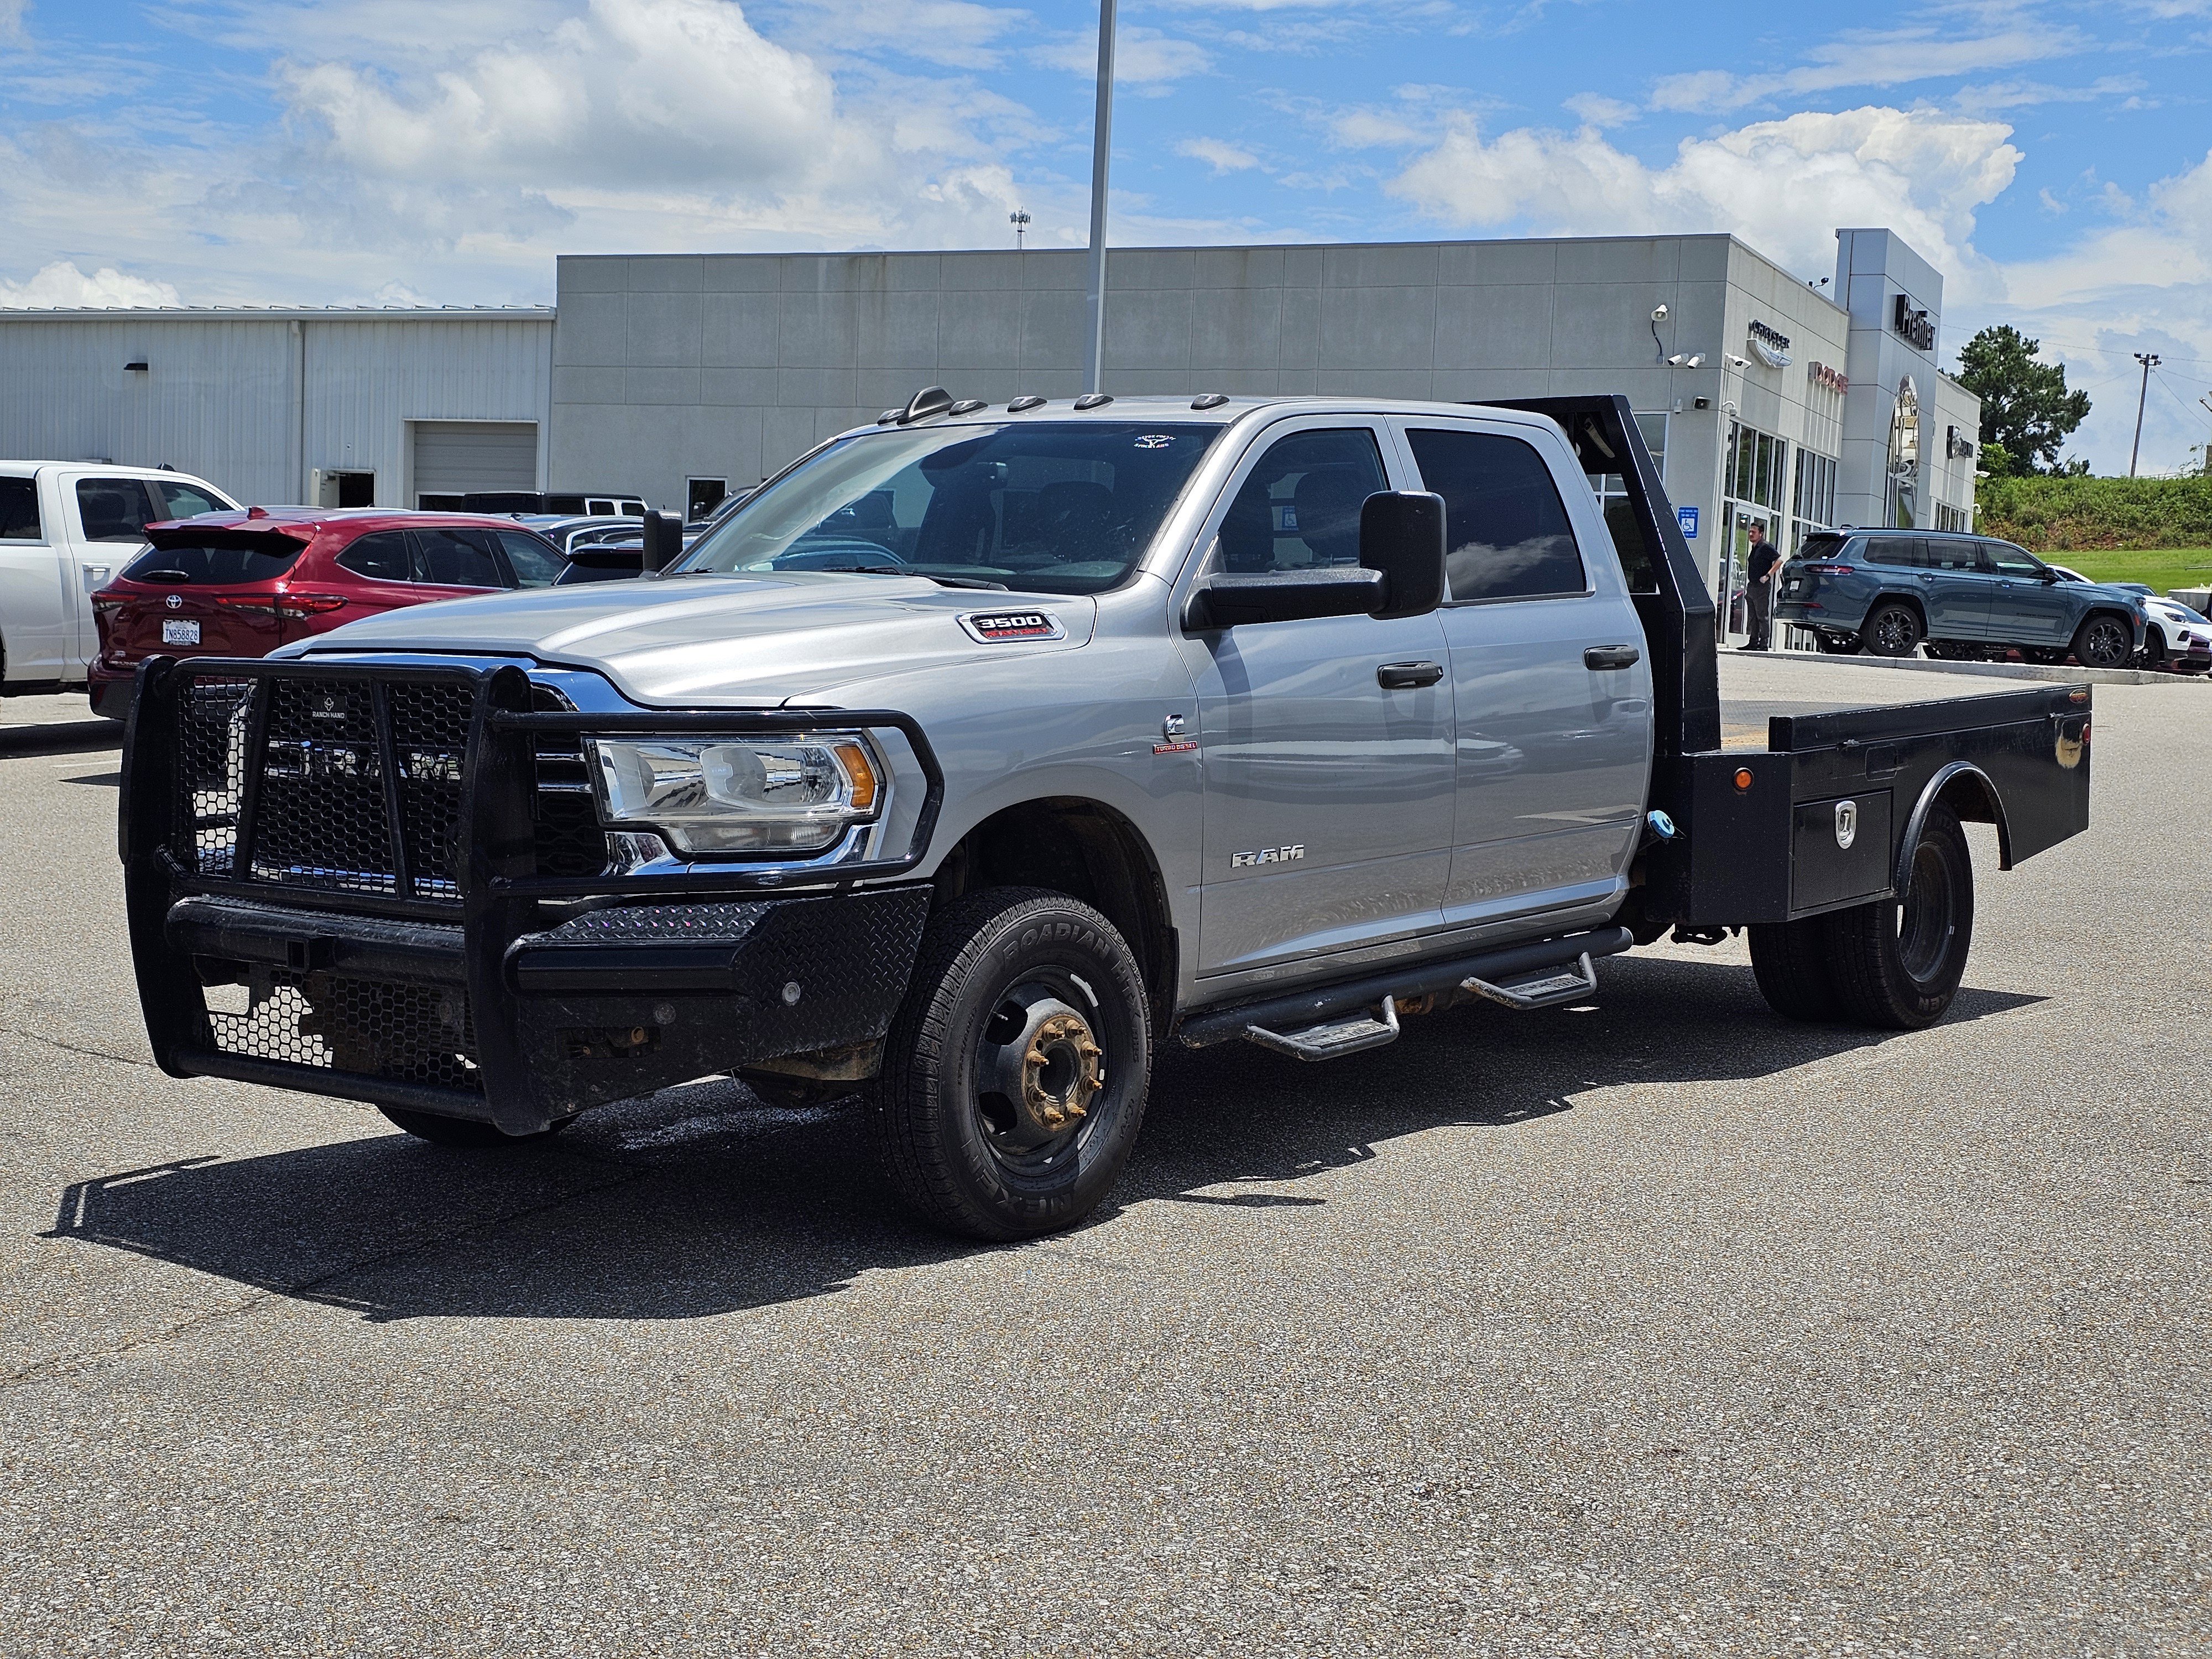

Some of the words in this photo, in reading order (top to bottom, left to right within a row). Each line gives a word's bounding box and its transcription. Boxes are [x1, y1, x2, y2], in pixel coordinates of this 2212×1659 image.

[1749, 320, 1790, 349] CHRYSLER
[1895, 294, 1936, 351] Premier
[1808, 362, 1849, 396] DODGE
[165, 628, 198, 640] TN858828
[977, 615, 1043, 630] 3500
[1230, 844, 1305, 868] RAM
[1003, 922, 1111, 971] ROADIAN
[1110, 959, 1141, 1019] HTX
